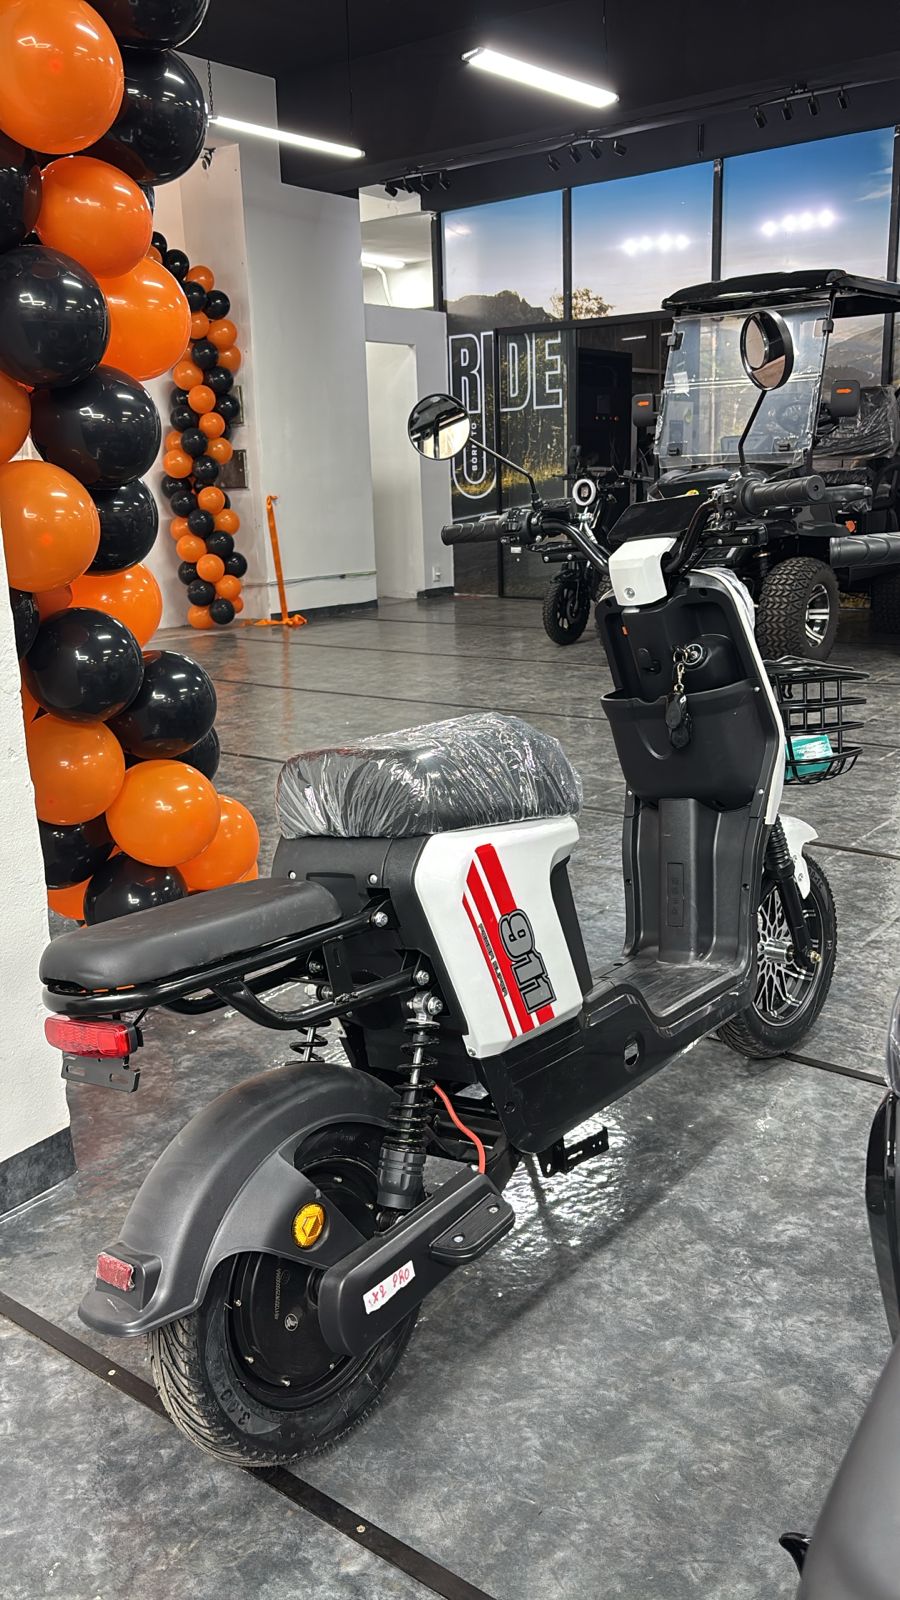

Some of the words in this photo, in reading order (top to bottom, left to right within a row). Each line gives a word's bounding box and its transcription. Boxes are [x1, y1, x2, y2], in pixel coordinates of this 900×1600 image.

[449, 331, 562, 414] RIDE
[471, 422, 478, 436] TO
[498, 908, 557, 1015] 911
[392, 1268, 410, 1288] PRO
